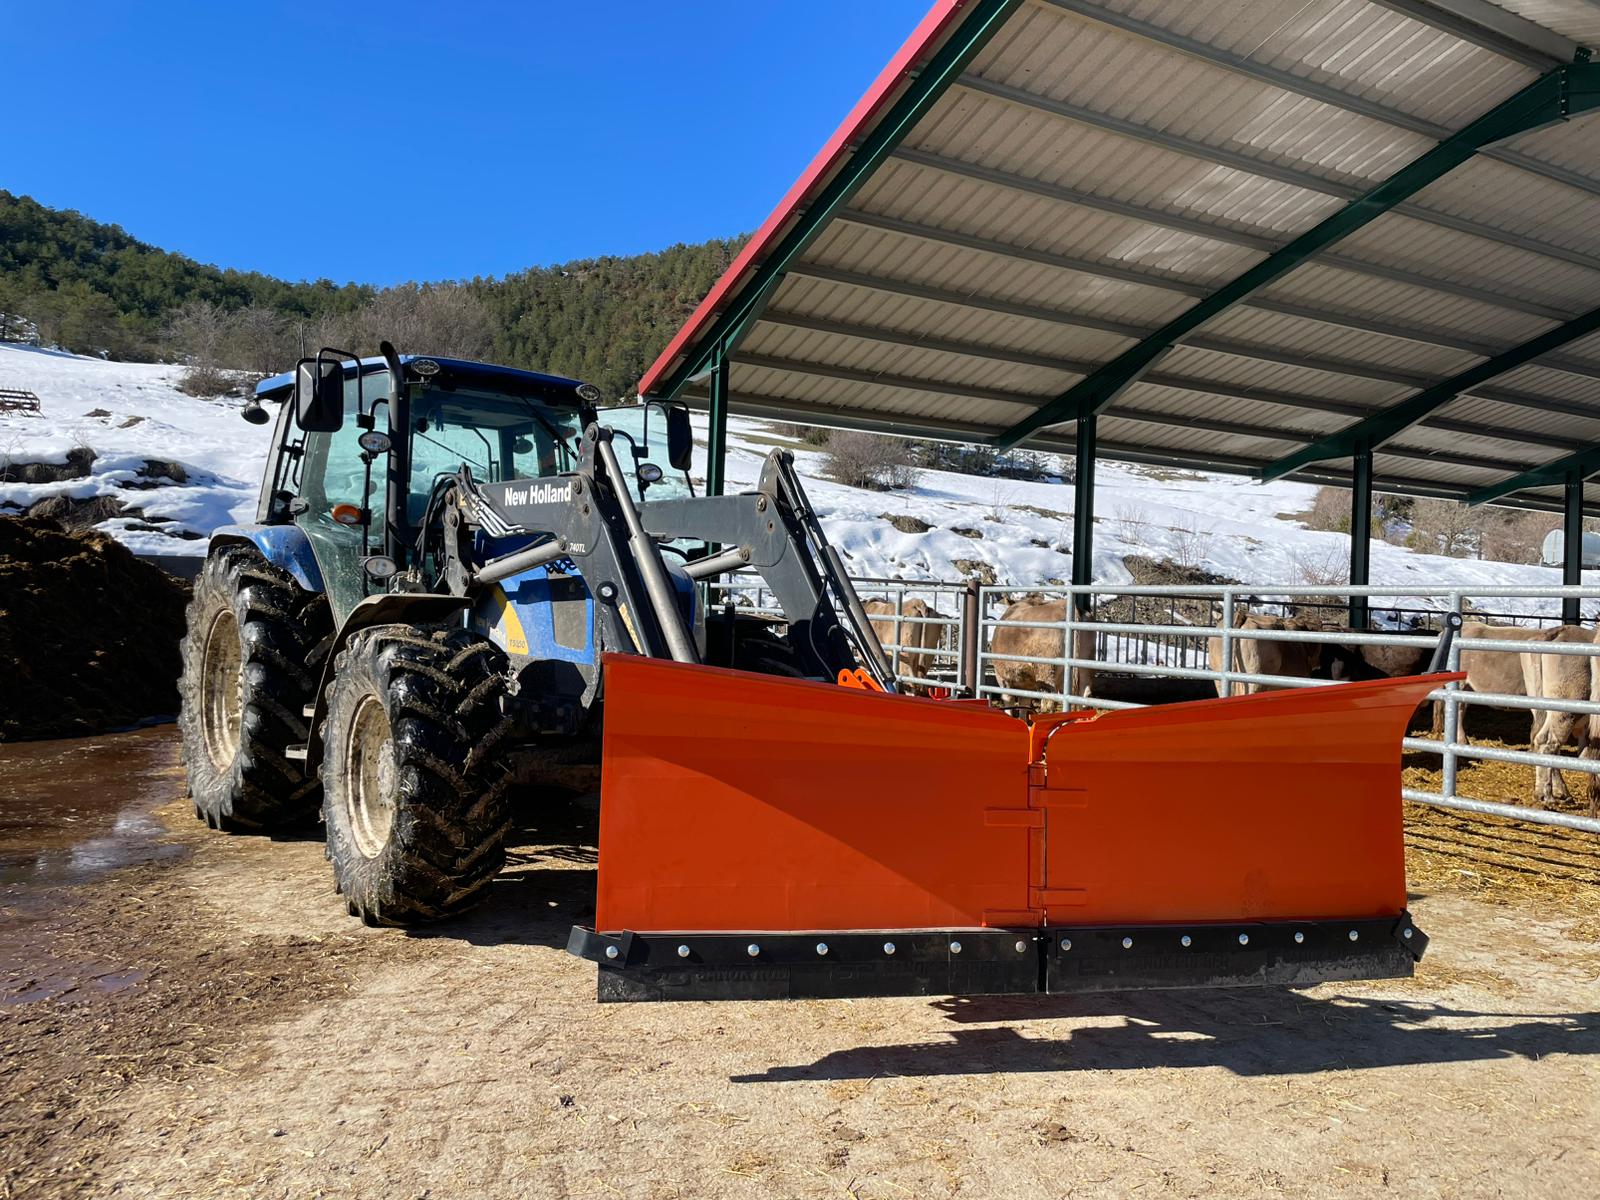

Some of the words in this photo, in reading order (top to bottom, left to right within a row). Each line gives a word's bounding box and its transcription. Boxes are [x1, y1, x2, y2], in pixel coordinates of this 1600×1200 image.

[504, 487, 528, 506] New
[529, 481, 572, 505] Holland
[569, 542, 586, 553] 740TL
